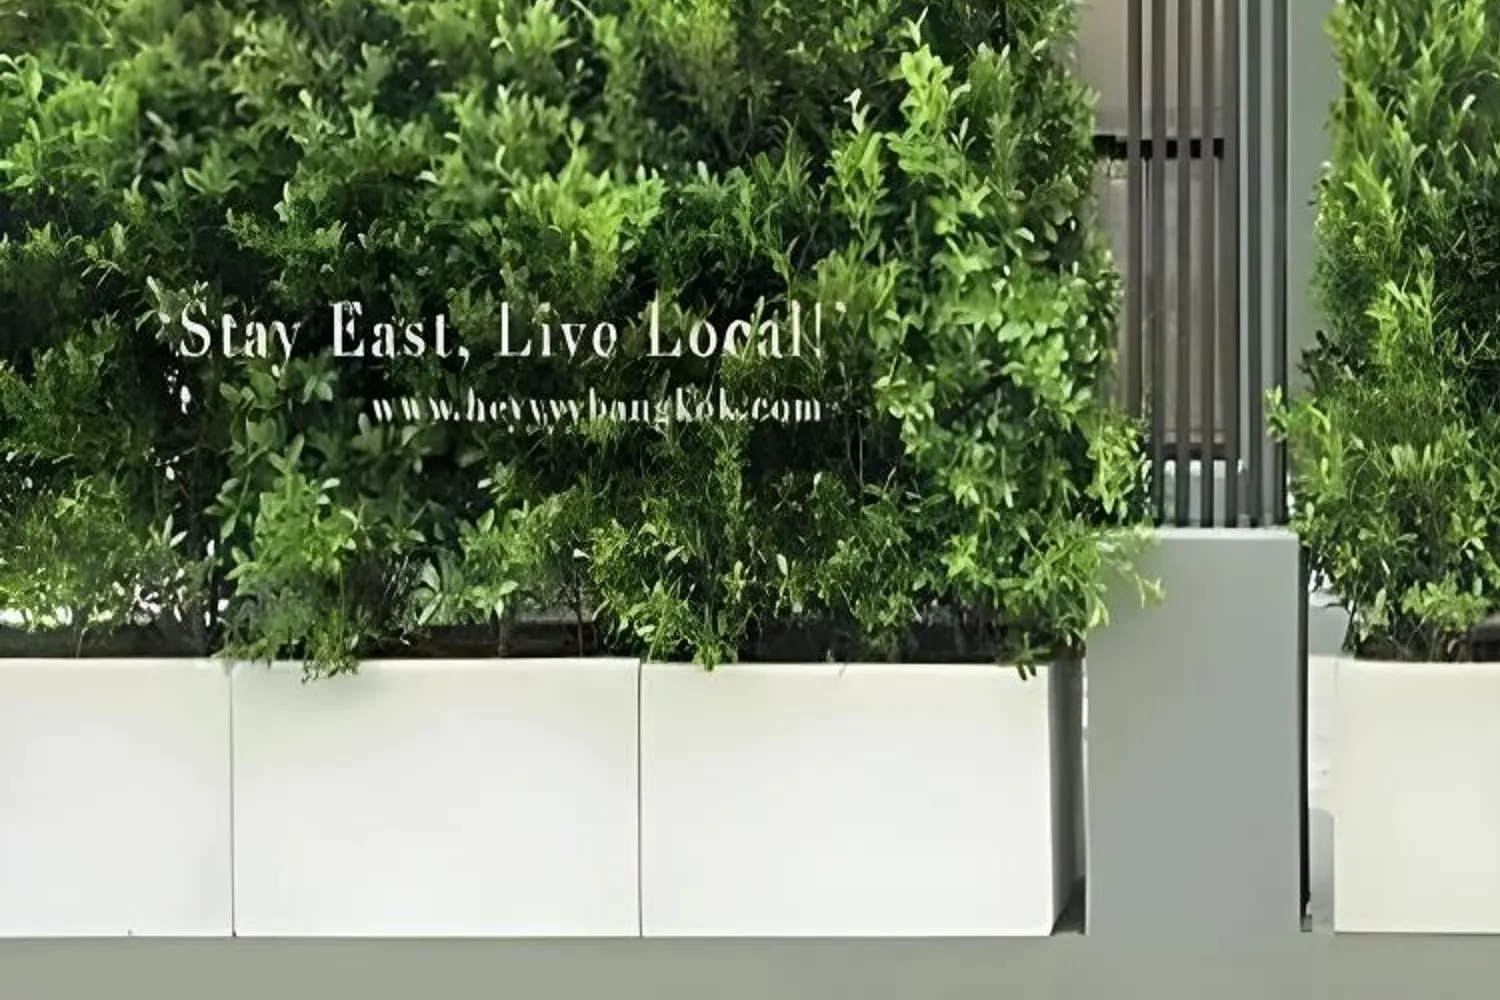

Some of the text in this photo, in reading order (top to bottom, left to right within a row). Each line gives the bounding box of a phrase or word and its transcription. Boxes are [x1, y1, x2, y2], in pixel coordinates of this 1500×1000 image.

[178, 296, 823, 372] Stay East, Live Local!
